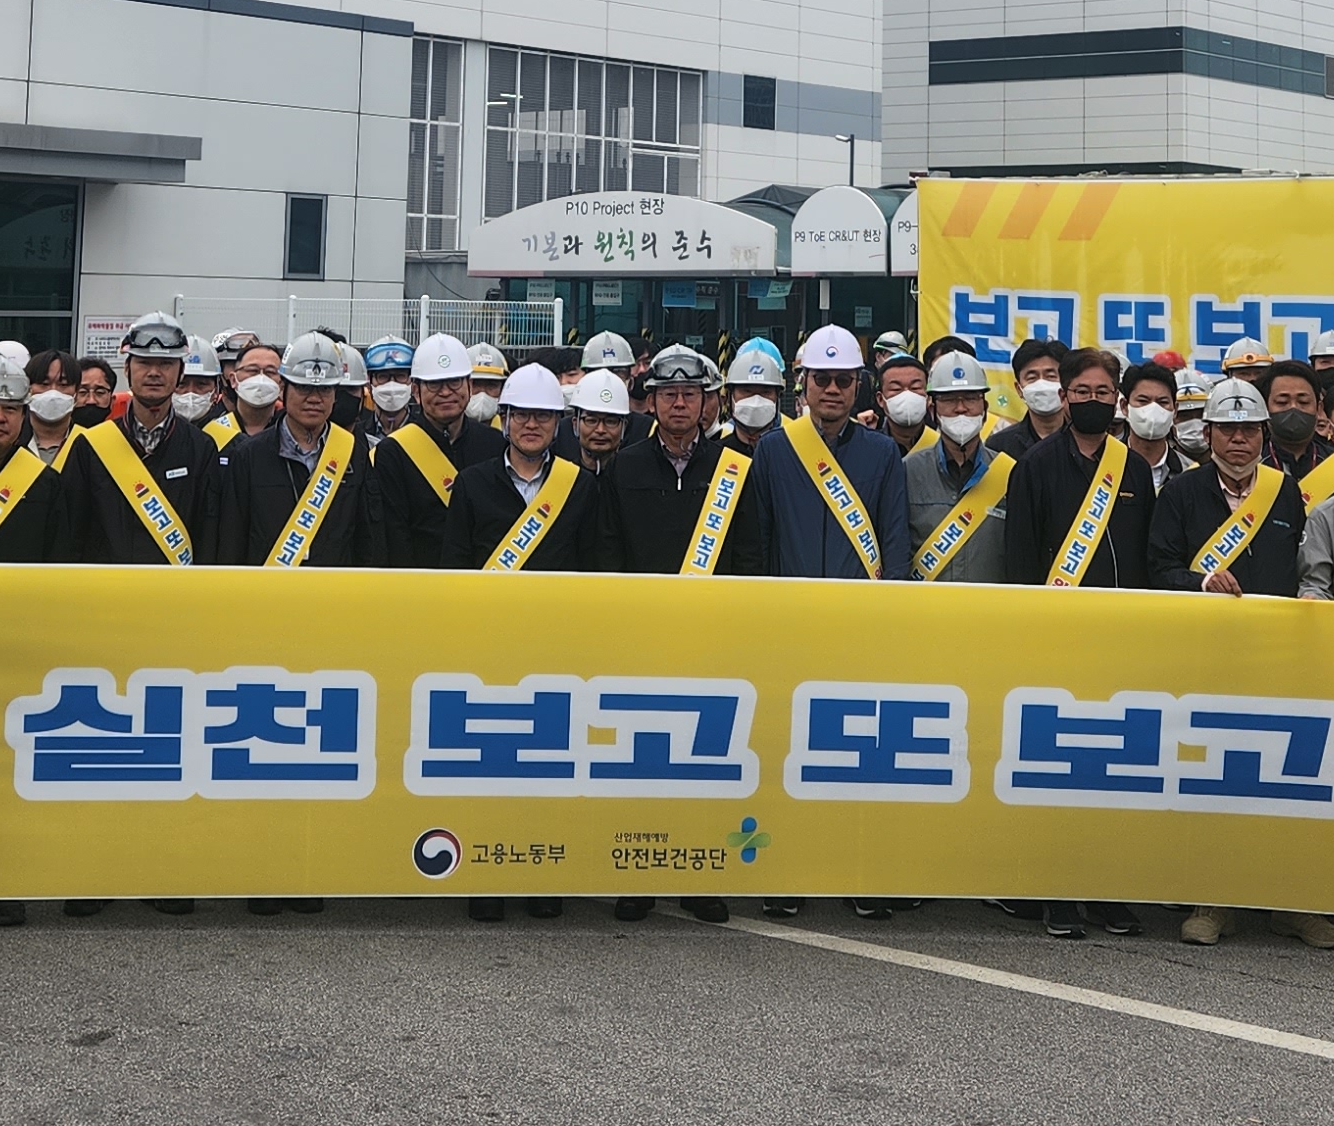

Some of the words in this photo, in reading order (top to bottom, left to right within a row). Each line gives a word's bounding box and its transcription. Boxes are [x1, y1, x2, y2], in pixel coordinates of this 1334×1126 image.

[566, 201, 588, 215] P10
[592, 200, 634, 217] Project
[639, 198, 664, 216] 현장
[522, 231, 583, 261] 기본과
[594, 227, 658, 263] 원칙의
[671, 229, 712, 260] 준수
[794, 231, 805, 242] P9
[829, 230, 860, 242] CR&UT
[863, 229, 881, 243] 현장
[954, 290, 1077, 365] 보고
[1102, 299, 1167, 364] 또
[307, 474, 333, 509] 보고
[713, 477, 735, 511] 보고
[823, 474, 854, 508] 보고
[1087, 485, 1111, 520] 보고
[142, 496, 173, 532] 보고
[512, 515, 543, 550] 보고
[932, 521, 963, 555] 보고
[1213, 522, 1247, 558] 보고
[692, 533, 717, 569] 보고
[1060, 540, 1088, 576] 보고
[23, 683, 359, 781] 실천
[422, 689, 743, 781] 보고
[800, 697, 953, 786] 또
[1012, 703, 1333, 803] 보고
[470, 843, 566, 866] 고용노동부
[614, 832, 669, 843] 산업재해예방
[612, 848, 727, 870] 안전보건공단
